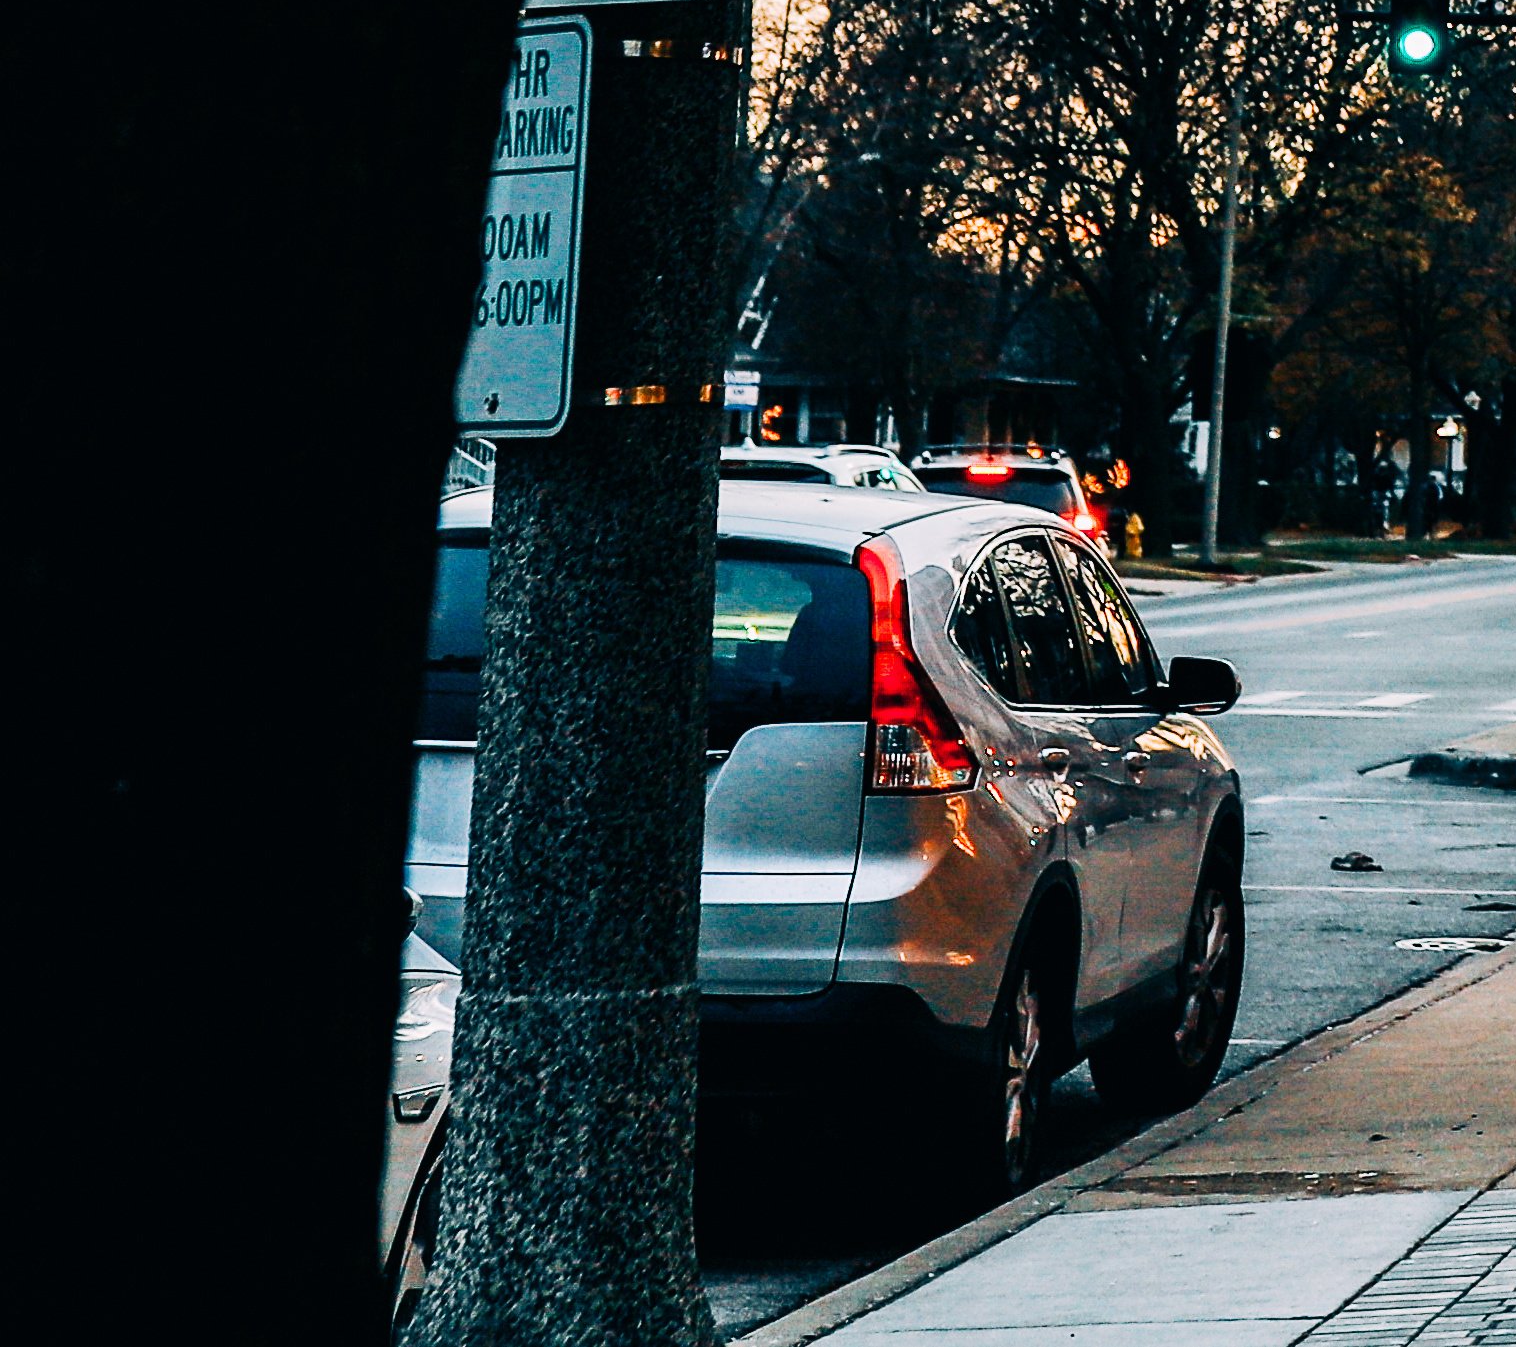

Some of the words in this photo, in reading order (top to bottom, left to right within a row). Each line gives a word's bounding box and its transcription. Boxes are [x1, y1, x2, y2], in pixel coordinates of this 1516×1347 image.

[512, 49, 550, 100] HR
[497, 105, 574, 159] ARKING
[479, 211, 551, 263] 00AM
[474, 278, 564, 327] 6:00PM
